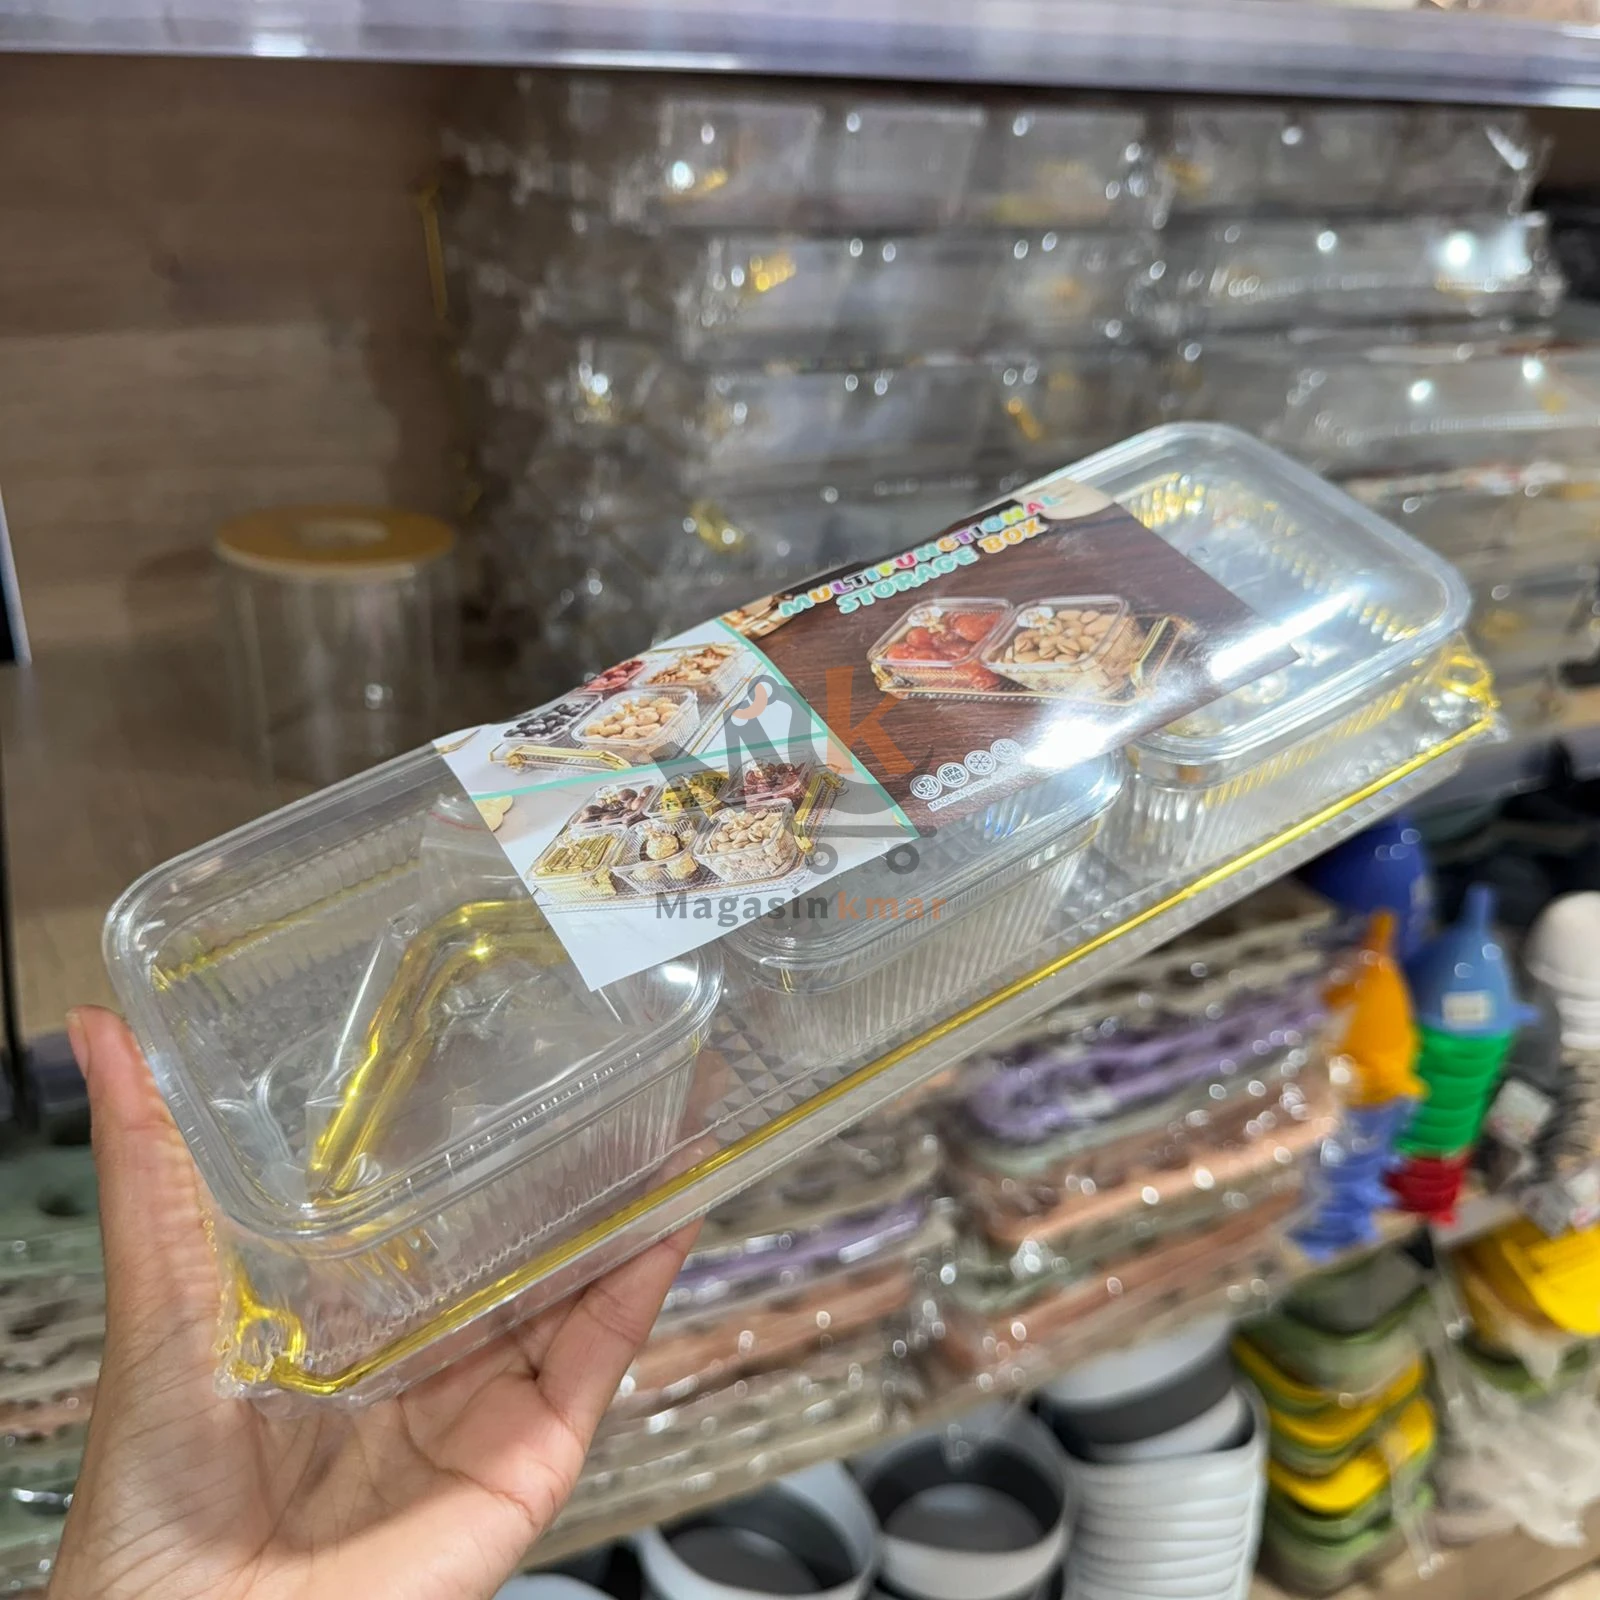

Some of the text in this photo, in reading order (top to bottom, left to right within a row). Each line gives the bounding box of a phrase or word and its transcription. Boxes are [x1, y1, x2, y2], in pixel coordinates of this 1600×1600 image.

[778, 494, 1062, 617] MULTIFUNCTIONAL
[836, 516, 1048, 614] STORAGE BOX
[942, 766, 960, 778] BPA
[947, 772, 965, 783] FREE
[929, 795, 953, 810] MADE
